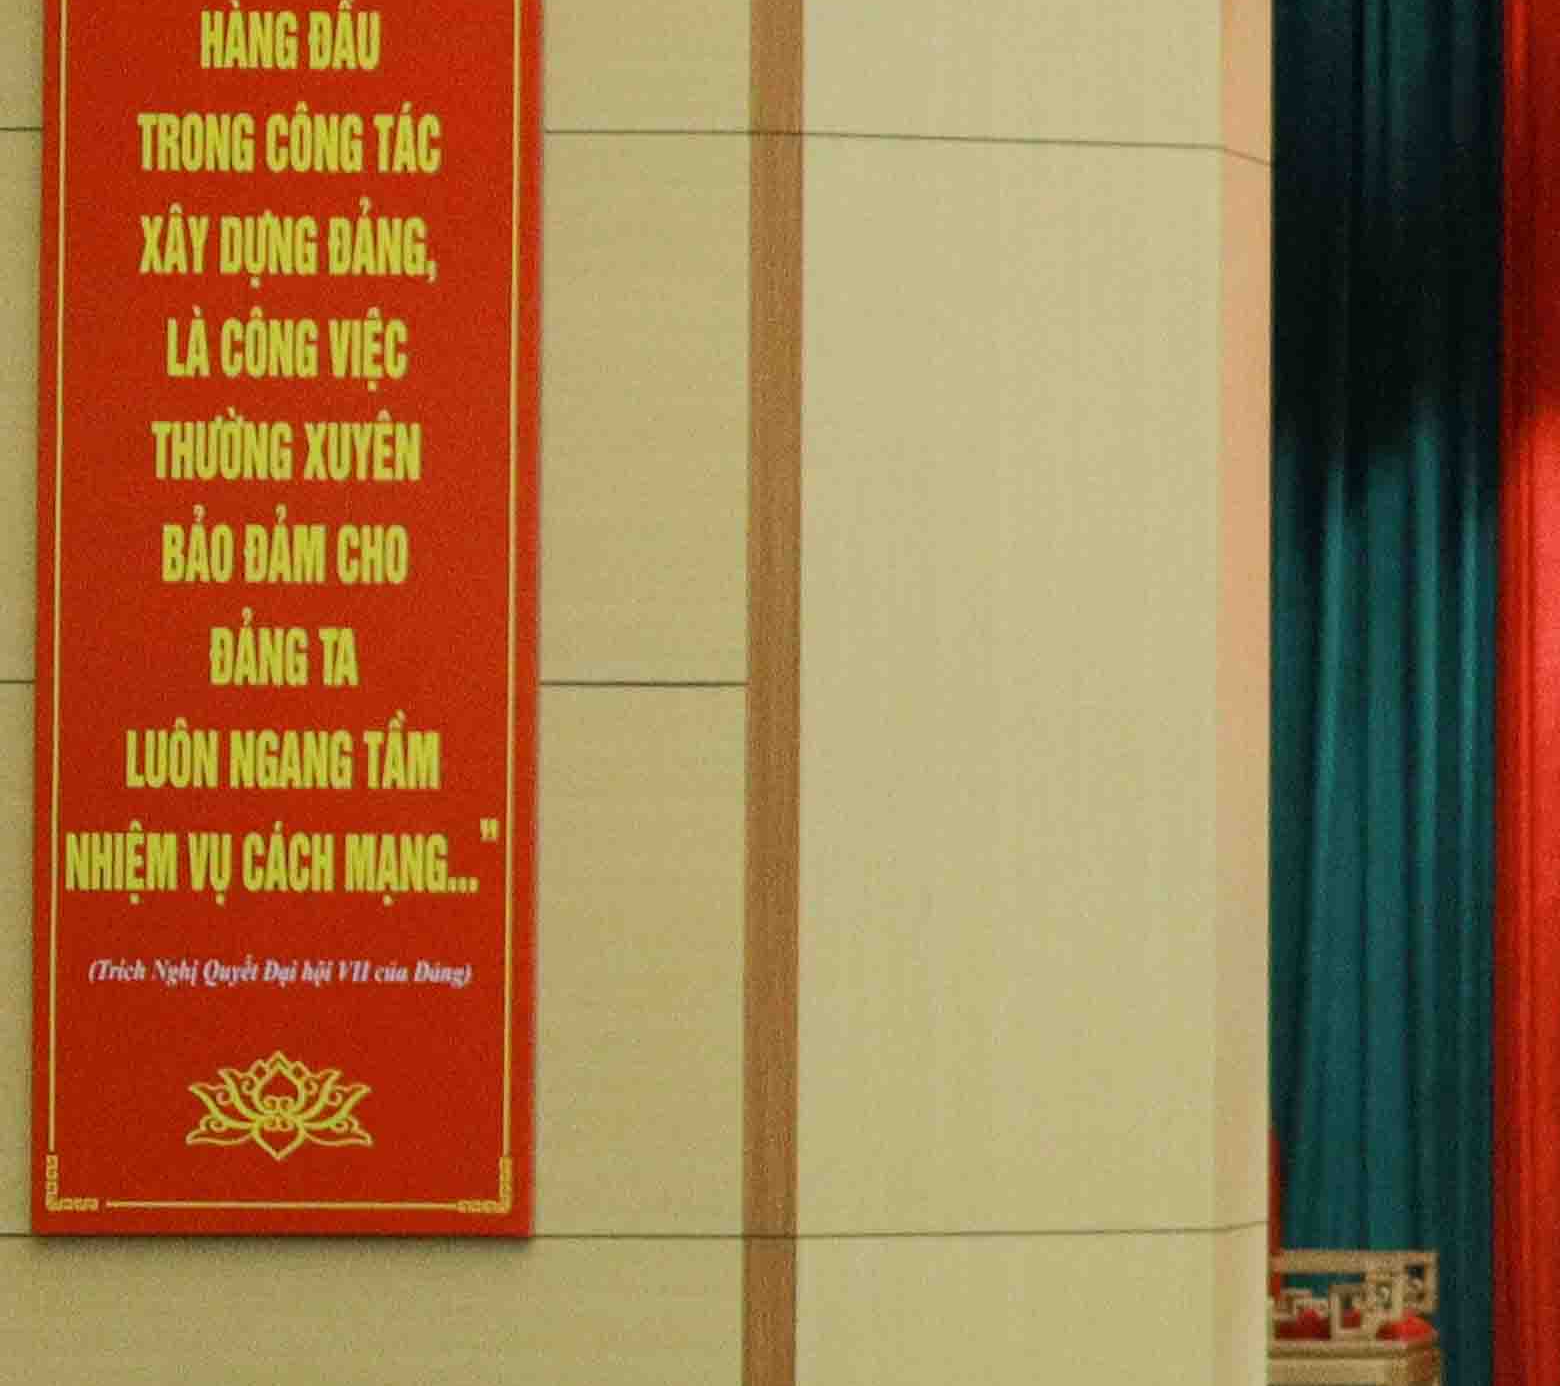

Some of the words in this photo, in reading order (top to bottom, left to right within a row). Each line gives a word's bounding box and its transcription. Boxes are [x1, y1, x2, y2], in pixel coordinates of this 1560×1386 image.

[201, 0, 298, 69] HÀNG
[138, 113, 254, 172] TRONG
[266, 102, 363, 172] CÔNG
[374, 102, 440, 173] TÁC
[141, 204, 208, 273] XÂY
[220, 211, 317, 287] DỰNG
[328, 198, 436, 281] ĐẢNG,
[168, 307, 209, 376] LÀ
[221, 307, 318, 377] CÔNG
[329, 308, 407, 390] VIỆC
[152, 407, 292, 480] THƯỜNG
[304, 410, 421, 481] XUYÊN
[210, 608, 308, 686] ĐẢNG
[319, 628, 358, 686] TA
[127, 718, 218, 788] LUÔN
[230, 730, 352, 789] NGANG
[364, 711, 440, 789] TẦM
[66, 820, 178, 905] NHIỆM
[189, 834, 231, 904] VỤ
[244, 821, 334, 891] CÁCH
